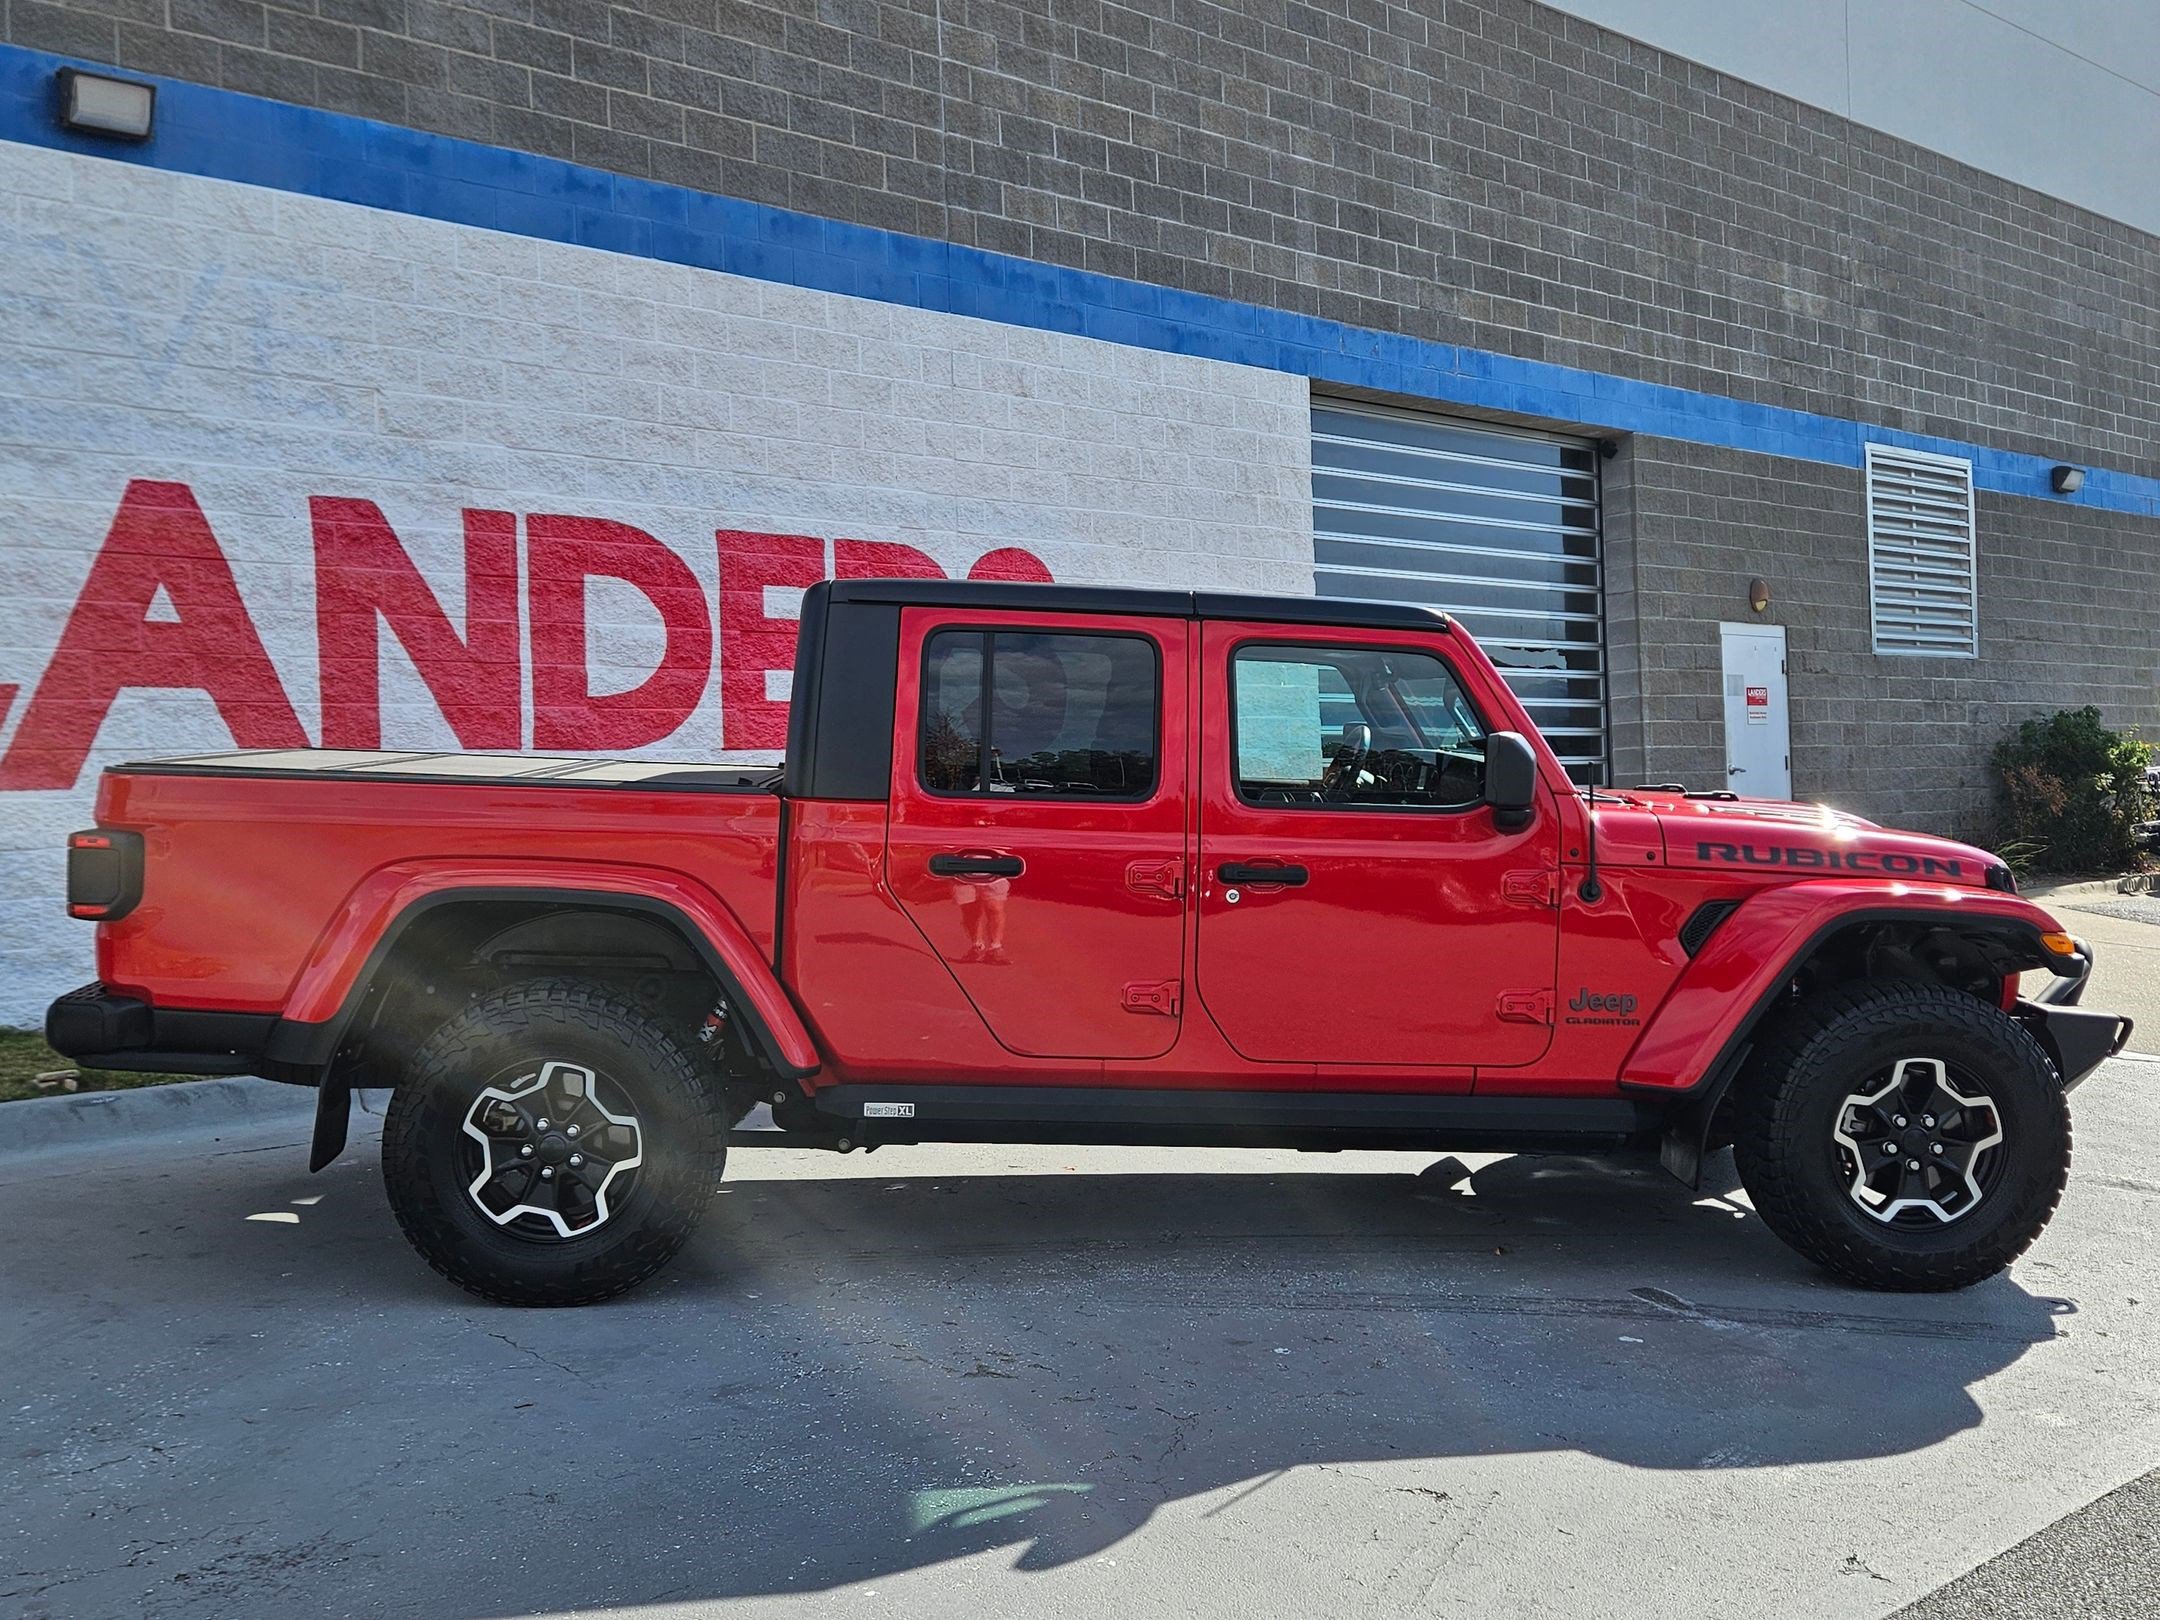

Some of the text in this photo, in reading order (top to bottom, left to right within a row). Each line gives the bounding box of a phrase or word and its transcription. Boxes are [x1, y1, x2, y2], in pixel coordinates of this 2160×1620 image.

[0, 482, 1055, 790] ANDE
[1696, 842, 1961, 876] RUBICON
[1569, 987, 1637, 1016] Jeep
[1565, 1017, 1640, 1026] GLADIATOR
[898, 1106, 912, 1116] XL
